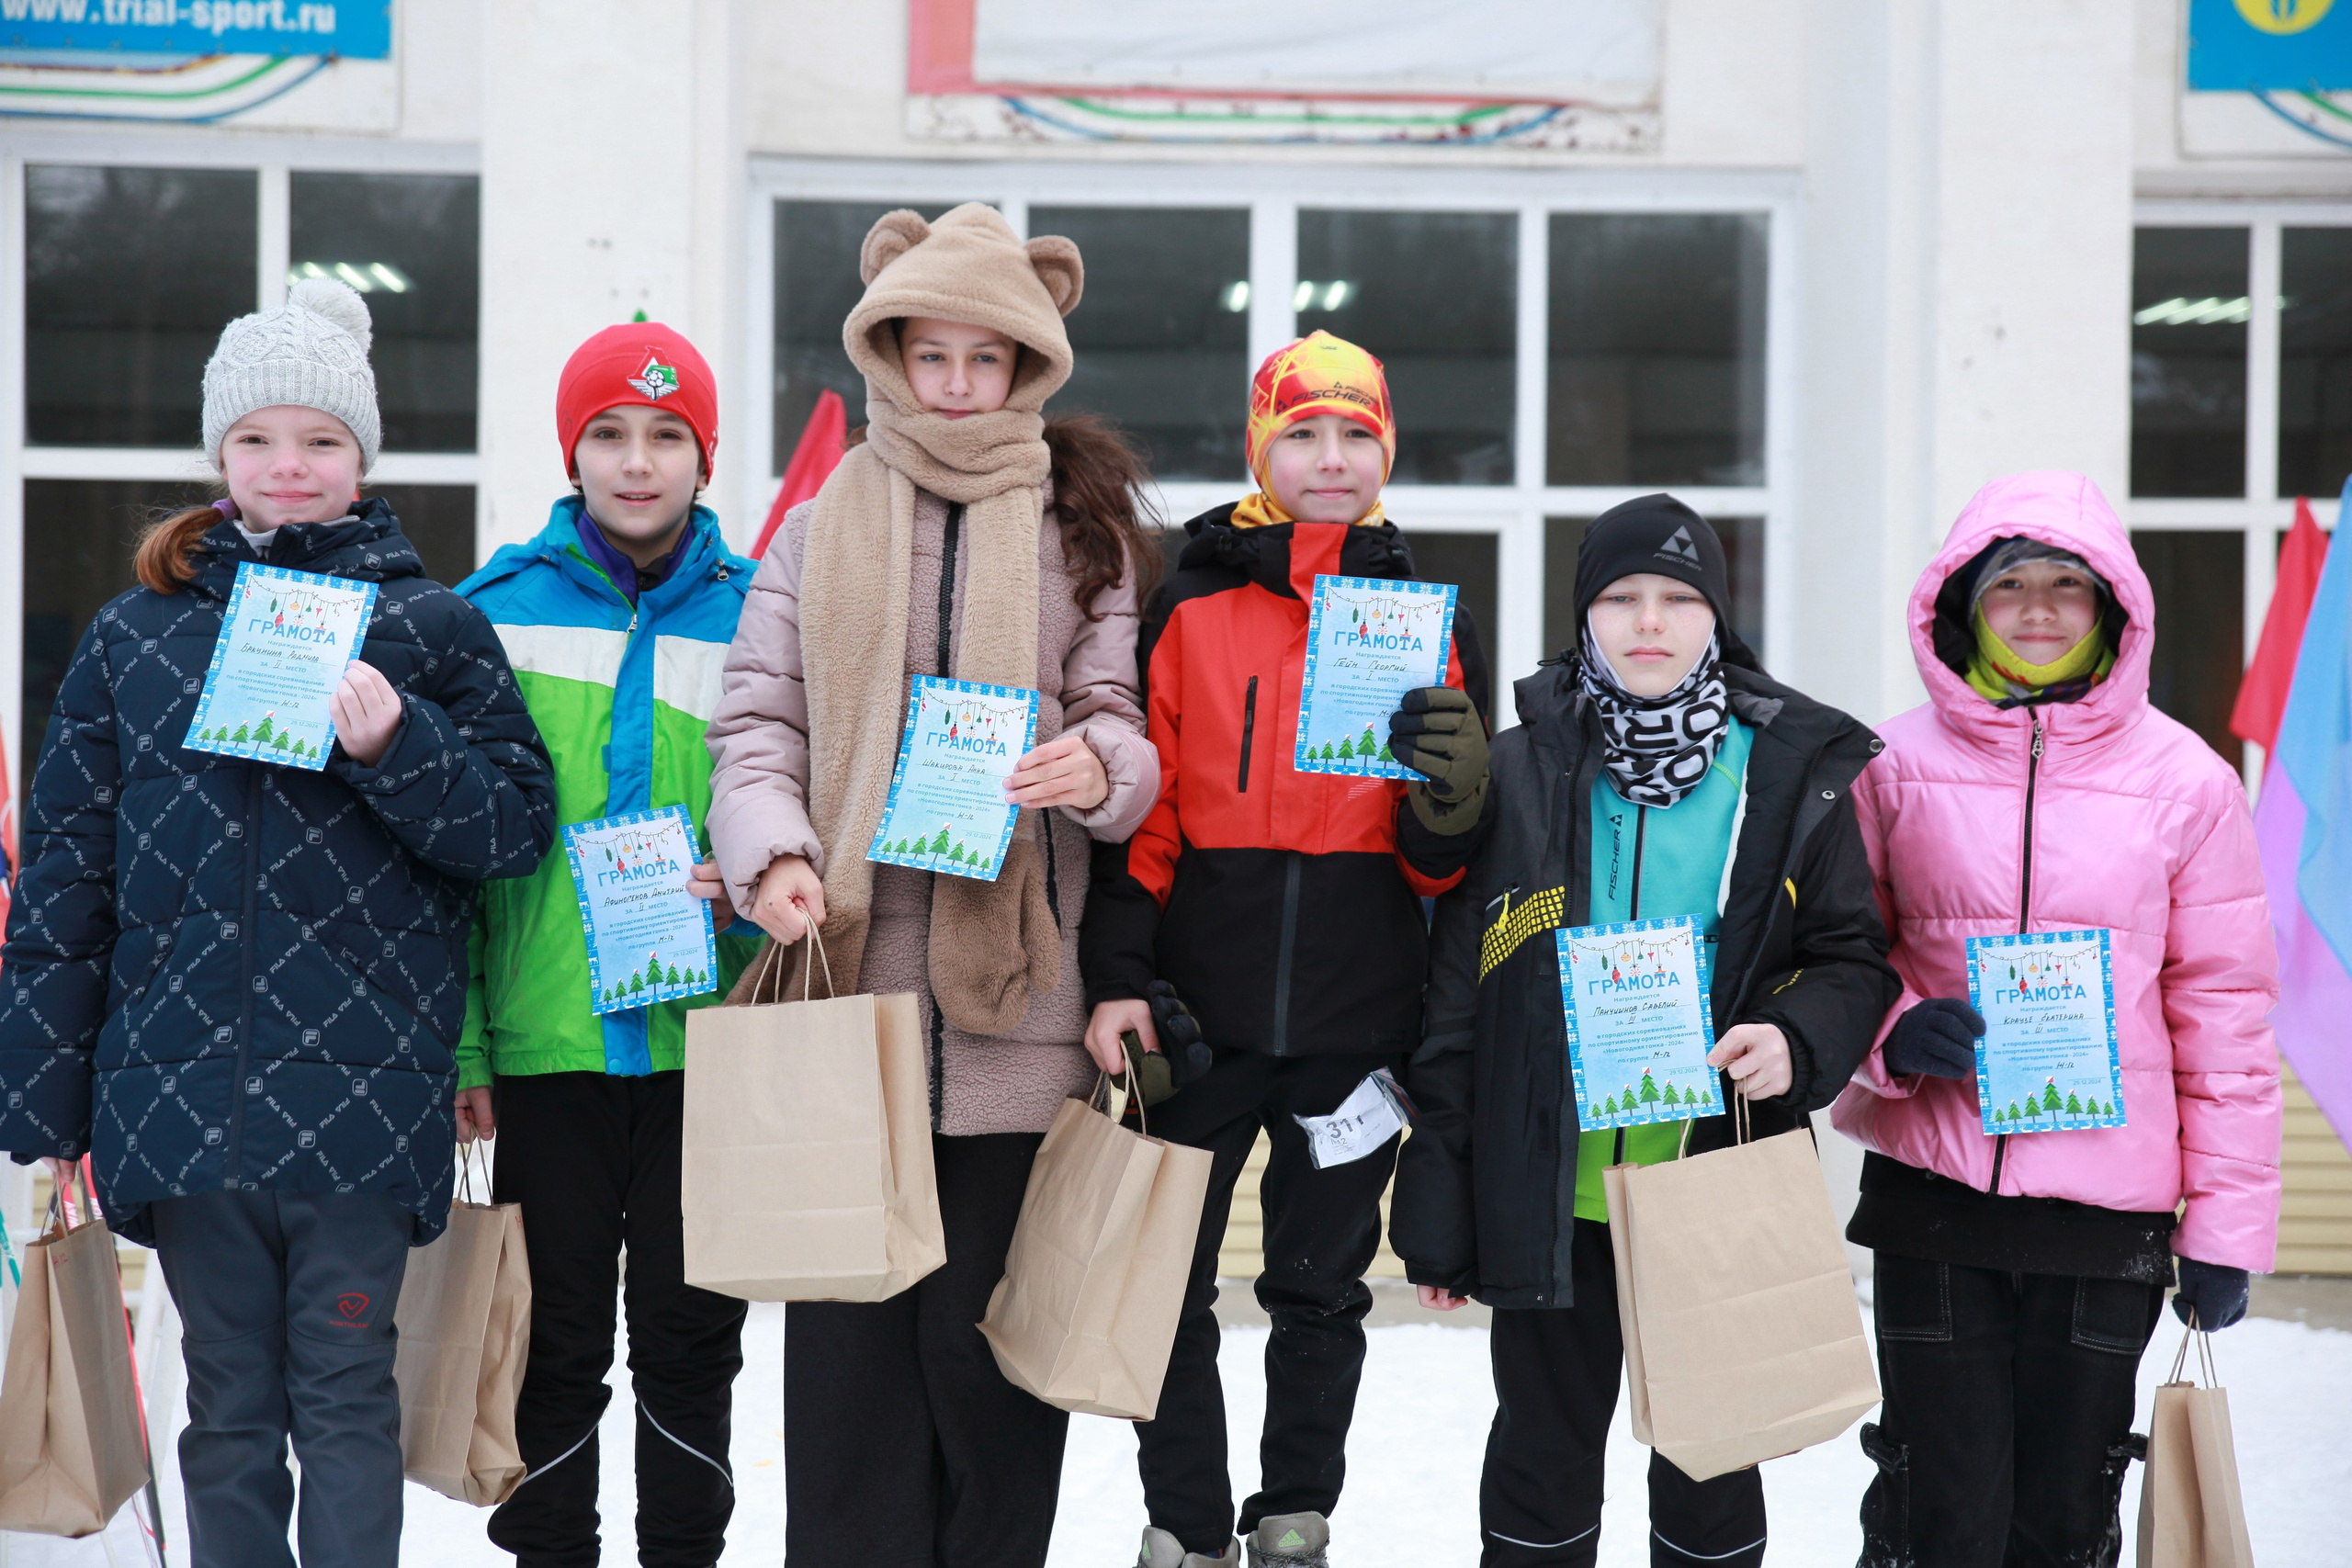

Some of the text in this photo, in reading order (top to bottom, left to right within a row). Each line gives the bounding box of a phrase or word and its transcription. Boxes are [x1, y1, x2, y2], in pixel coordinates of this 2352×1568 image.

[2, 0, 336, 36] www.trial-sport.ru
[1291, 389, 1371, 407] FISCHER
[1653, 552, 1702, 572] FISCHER
[248, 621, 339, 645] ГРАМОТА
[266, 640, 311, 651] Награждается
[1335, 633, 1425, 651] ГРАМОТА
[1355, 652, 1400, 660] Награждается
[234, 677, 277, 687] спортивному
[242, 670, 276, 679] городских
[276, 676, 324, 687] соревнованиях
[926, 734, 1009, 756] ГРАМОТА
[944, 753, 985, 763] Награждается
[198, 791, 209, 805] FILA
[914, 789, 953, 799] спортивному
[953, 796, 1005, 808] ориентированию
[922, 783, 952, 792] городских
[952, 789, 997, 799] соревнованиях
[166, 795, 180, 810] FILA
[275, 791, 289, 807] FILA
[210, 803, 224, 818] FILA
[153, 813, 165, 829] FILA
[154, 850, 167, 864] FILA
[287, 844, 302, 857] FILA
[169, 863, 183, 877] FILA
[269, 859, 286, 873] FILA
[1608, 829, 1622, 901] FISCHER
[598, 861, 681, 886] ГРАМОТА
[621, 881, 663, 892] Награждается
[609, 925, 648, 935] спортивному
[649, 915, 698, 928] ориентированию
[614, 917, 644, 927] городских
[644, 909, 688, 921] соревнованиях
[201, 942, 217, 955] FILA
[636, 941, 655, 949] группе
[187, 958, 200, 973] FILA
[1589, 973, 1680, 995] ГРАМОТА
[270, 995, 284, 1010] FILA
[1613, 992, 1659, 1002] Награждается
[1996, 987, 2087, 1004] ГРАМОТА
[338, 998, 352, 1011] FILA
[323, 1013, 338, 1028] FILA
[1597, 1038, 1639, 1047] спортивному
[1641, 1032, 1698, 1042] ориентированию
[1601, 1031, 1635, 1039] городских
[1636, 1025, 1686, 1035] соревнованиях
[2046, 1043, 2103, 1052] ориентированию
[26, 1074, 40, 1089] FILA
[266, 1096, 280, 1111] FILA
[335, 1098, 350, 1112] FILA
[25, 1110, 40, 1126] FILA
[282, 1111, 297, 1127] FILA
[320, 1114, 335, 1129] FILA
[42, 1125, 58, 1141] FILA
